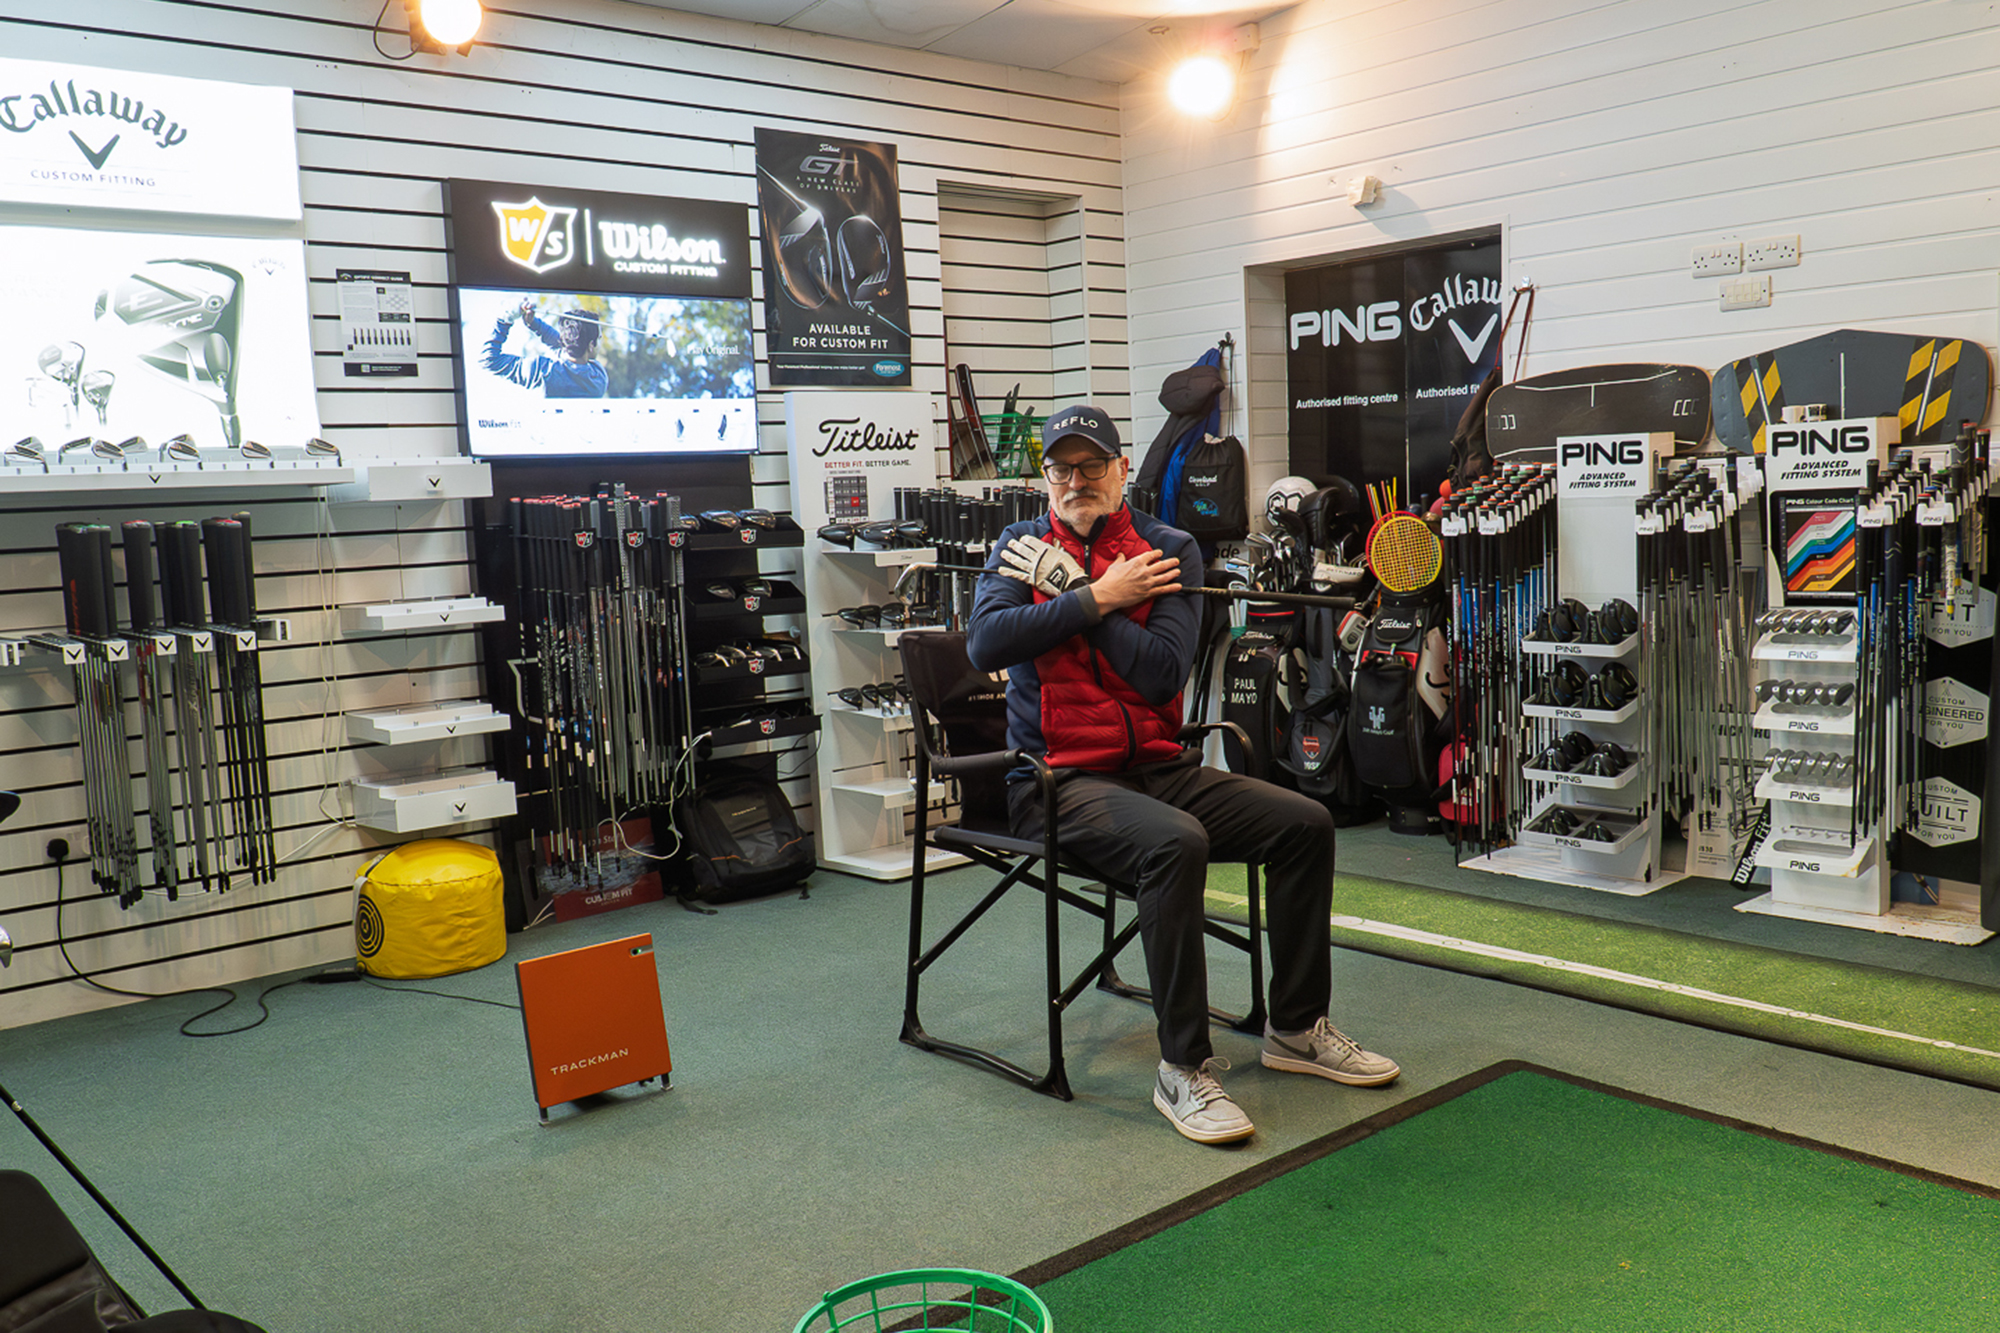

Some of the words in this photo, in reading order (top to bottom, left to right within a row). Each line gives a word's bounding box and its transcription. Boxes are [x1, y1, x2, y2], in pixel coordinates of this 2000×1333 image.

[0, 79, 187, 148] Callaway
[800, 155, 859, 176] GT
[30, 170, 94, 182] CUSTOM
[100, 174, 156, 186] FITTING
[818, 185, 856, 193] DRIVERS
[508, 216, 541, 243] W
[544, 230, 564, 256] S
[598, 221, 726, 264] Wilson
[614, 261, 668, 274] CUSTOM
[670, 265, 718, 277] FITTING
[1409, 273, 1502, 331] Callaw
[809, 324, 871, 335] AVAILABLE
[1290, 300, 1402, 350] PING
[792, 337, 816, 348] FOR
[820, 338, 866, 348] CUSTOM
[870, 340, 888, 349] FIT
[1416, 386, 1468, 399] Authorised
[1296, 398, 1341, 409] Authorised
[1343, 394, 1368, 406] fitting
[1370, 392, 1398, 404] centre
[478, 419, 508, 428] Wilson
[1053, 416, 1098, 430] REFLO
[812, 417, 919, 457] Titleist
[1772, 426, 1870, 457] PING
[1562, 440, 1644, 467] PING
[1793, 460, 1849, 471] ADVANCED
[1579, 472, 1626, 480] ADVANCED
[1780, 470, 1818, 480] FITTING
[1822, 468, 1862, 478] SYSTEM
[1568, 481, 1600, 489] FITTING
[1604, 480, 1636, 488] SYSTEM
[1931, 602, 1976, 622] FT
[1555, 645, 1582, 654] PING
[1788, 650, 1819, 660] PING
[1234, 678, 1257, 690] PAUL
[1231, 692, 1258, 704] MAYO
[1928, 696, 1965, 705] CUSTOM
[1555, 710, 1582, 719] PING
[1788, 721, 1819, 732] PING
[1555, 774, 1582, 784] PING
[1928, 785, 1958, 794] USTOM
[1790, 791, 1821, 802] PING
[1921, 804, 1969, 822] UILT
[1555, 838, 1582, 848] PING
[1790, 860, 1820, 872] PING
[550, 1047, 629, 1076] TRACKMAN
